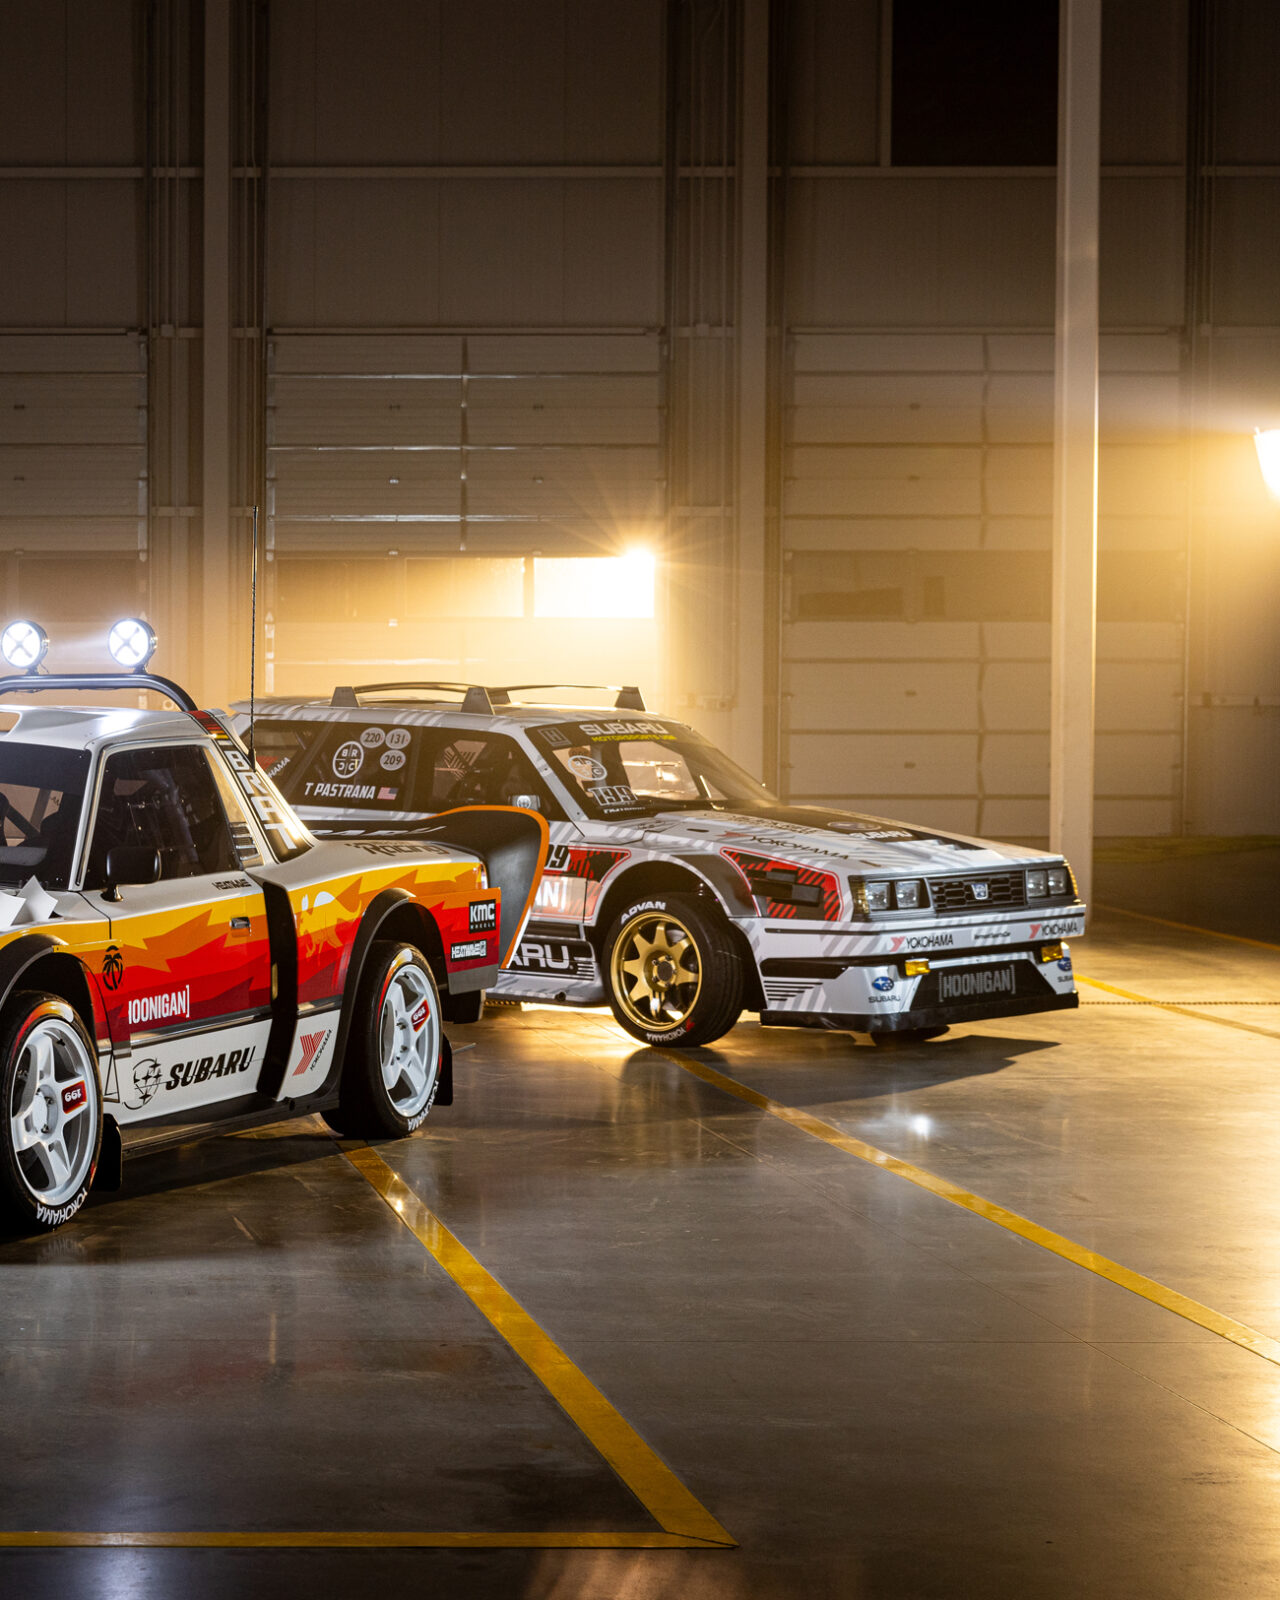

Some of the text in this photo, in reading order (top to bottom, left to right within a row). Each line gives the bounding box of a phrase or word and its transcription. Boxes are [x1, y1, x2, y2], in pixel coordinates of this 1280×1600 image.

[364, 733, 380, 743] 220
[390, 733, 406, 744] 131
[579, 723, 669, 736] SUBARU
[268, 757, 291, 778] HAMA
[384, 755, 402, 765] 209
[224, 750, 297, 850] BRAT
[304, 782, 376, 799] T PASTRANA
[750, 836, 849, 860] YOKOHAMA
[621, 901, 666, 924] ADVAN
[1041, 921, 1078, 936] YOKOHAMA
[906, 934, 953, 949] YOKOHAMA
[939, 964, 1016, 1002] [HOONIGAN]
[868, 994, 901, 1003] SUBARU
[310, 1029, 333, 1071] YOKOHAMA
[166, 1045, 256, 1090] SUBARU
[36, 1187, 88, 1225] YOKOHAMA
